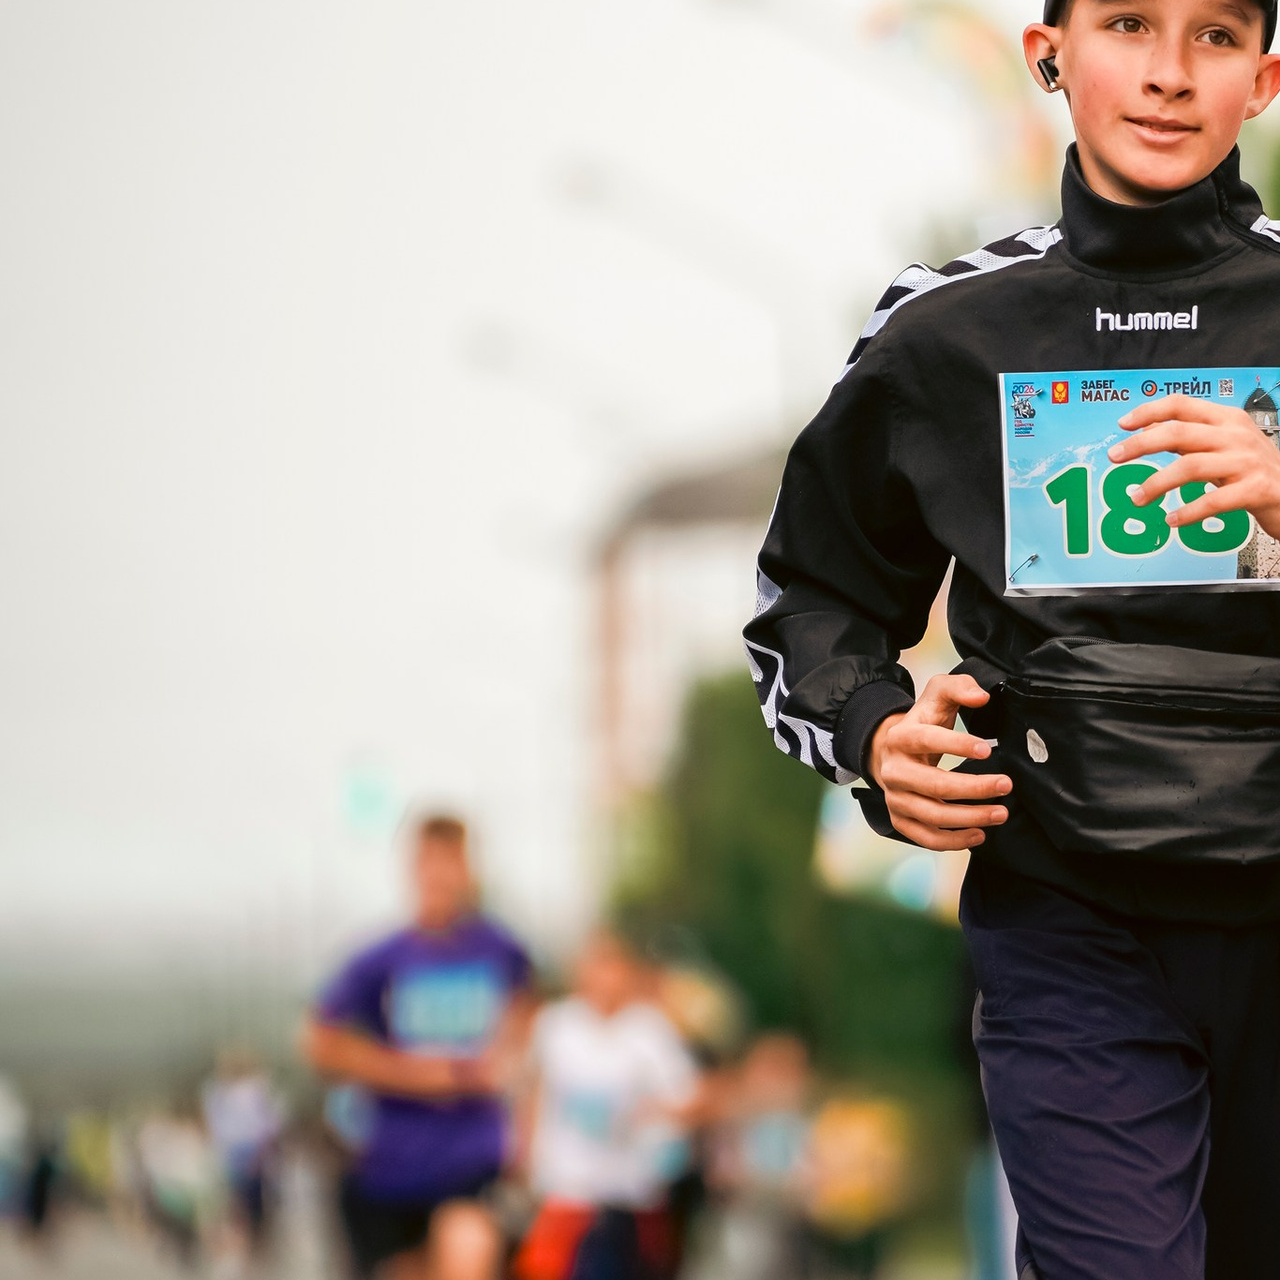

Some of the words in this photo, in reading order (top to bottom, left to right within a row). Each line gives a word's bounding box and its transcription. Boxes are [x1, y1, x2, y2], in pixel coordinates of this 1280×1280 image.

[1095, 304, 1199, 332] hummel
[1012, 384, 1035, 394] 2026
[1081, 379, 1115, 390] ЗАБЕГ
[1081, 389, 1130, 402] МАГАС
[1044, 462, 1251, 556] 188
